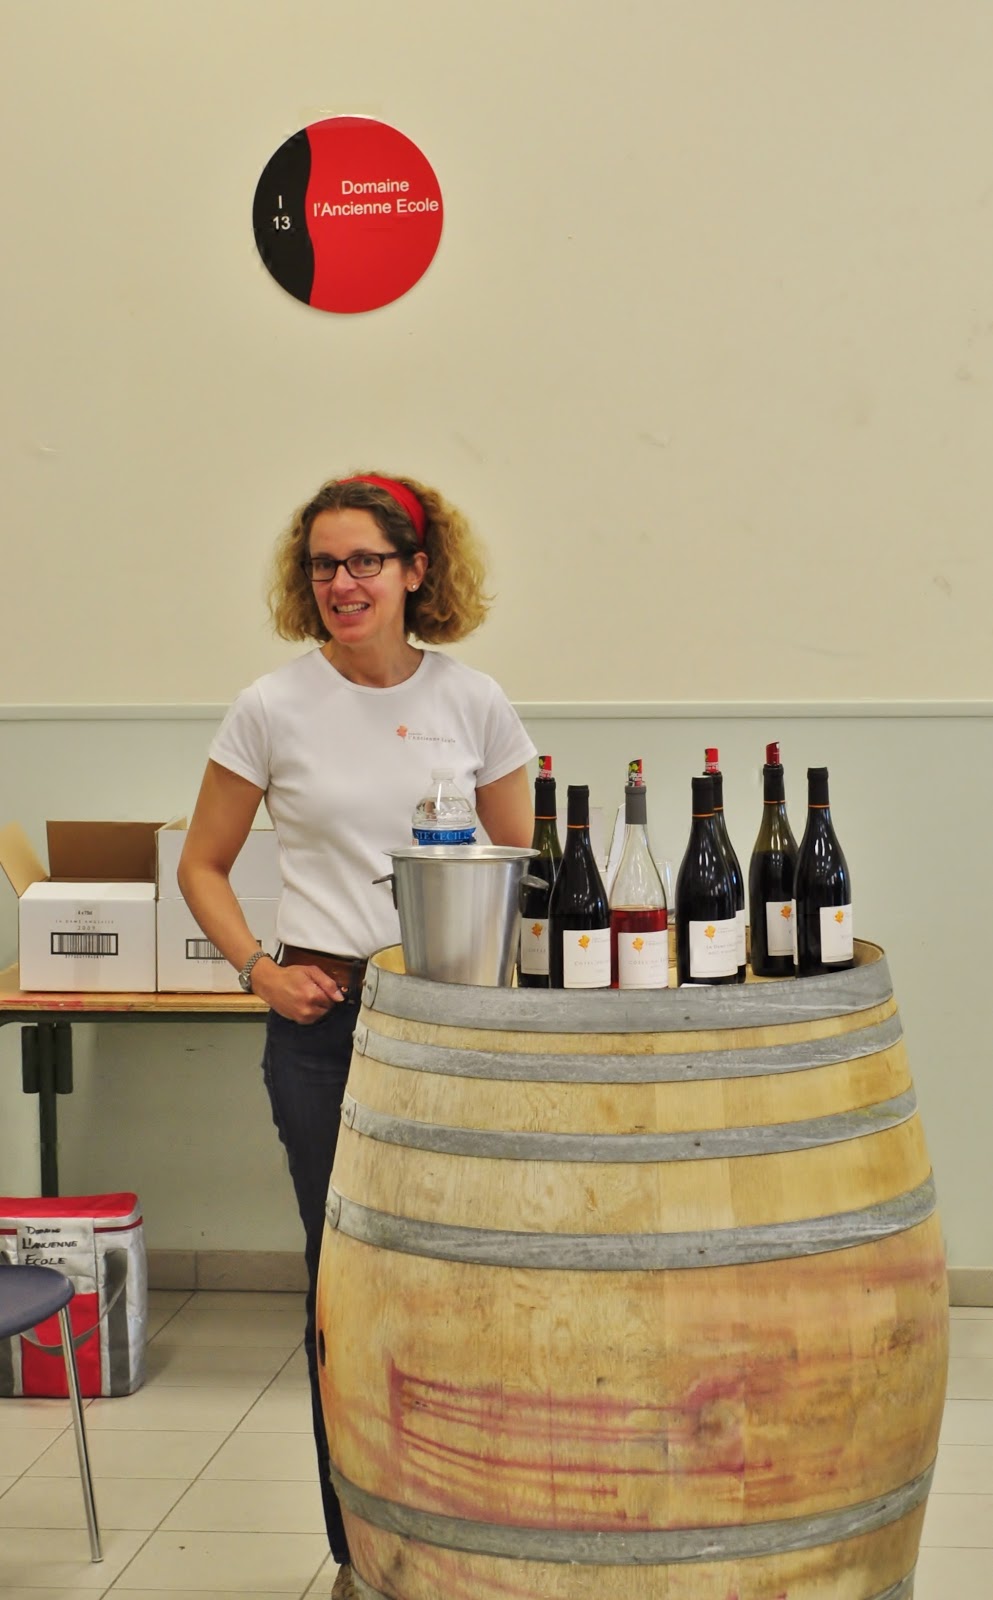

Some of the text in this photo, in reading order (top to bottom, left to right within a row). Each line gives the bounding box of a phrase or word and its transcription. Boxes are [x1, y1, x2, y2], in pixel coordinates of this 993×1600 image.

[341, 179, 410, 195] Domaine
[313, 198, 439, 217] l'Ancienne Ecole
[272, 216, 291, 230] 13
[25, 1254, 66, 1265] ECOLE
